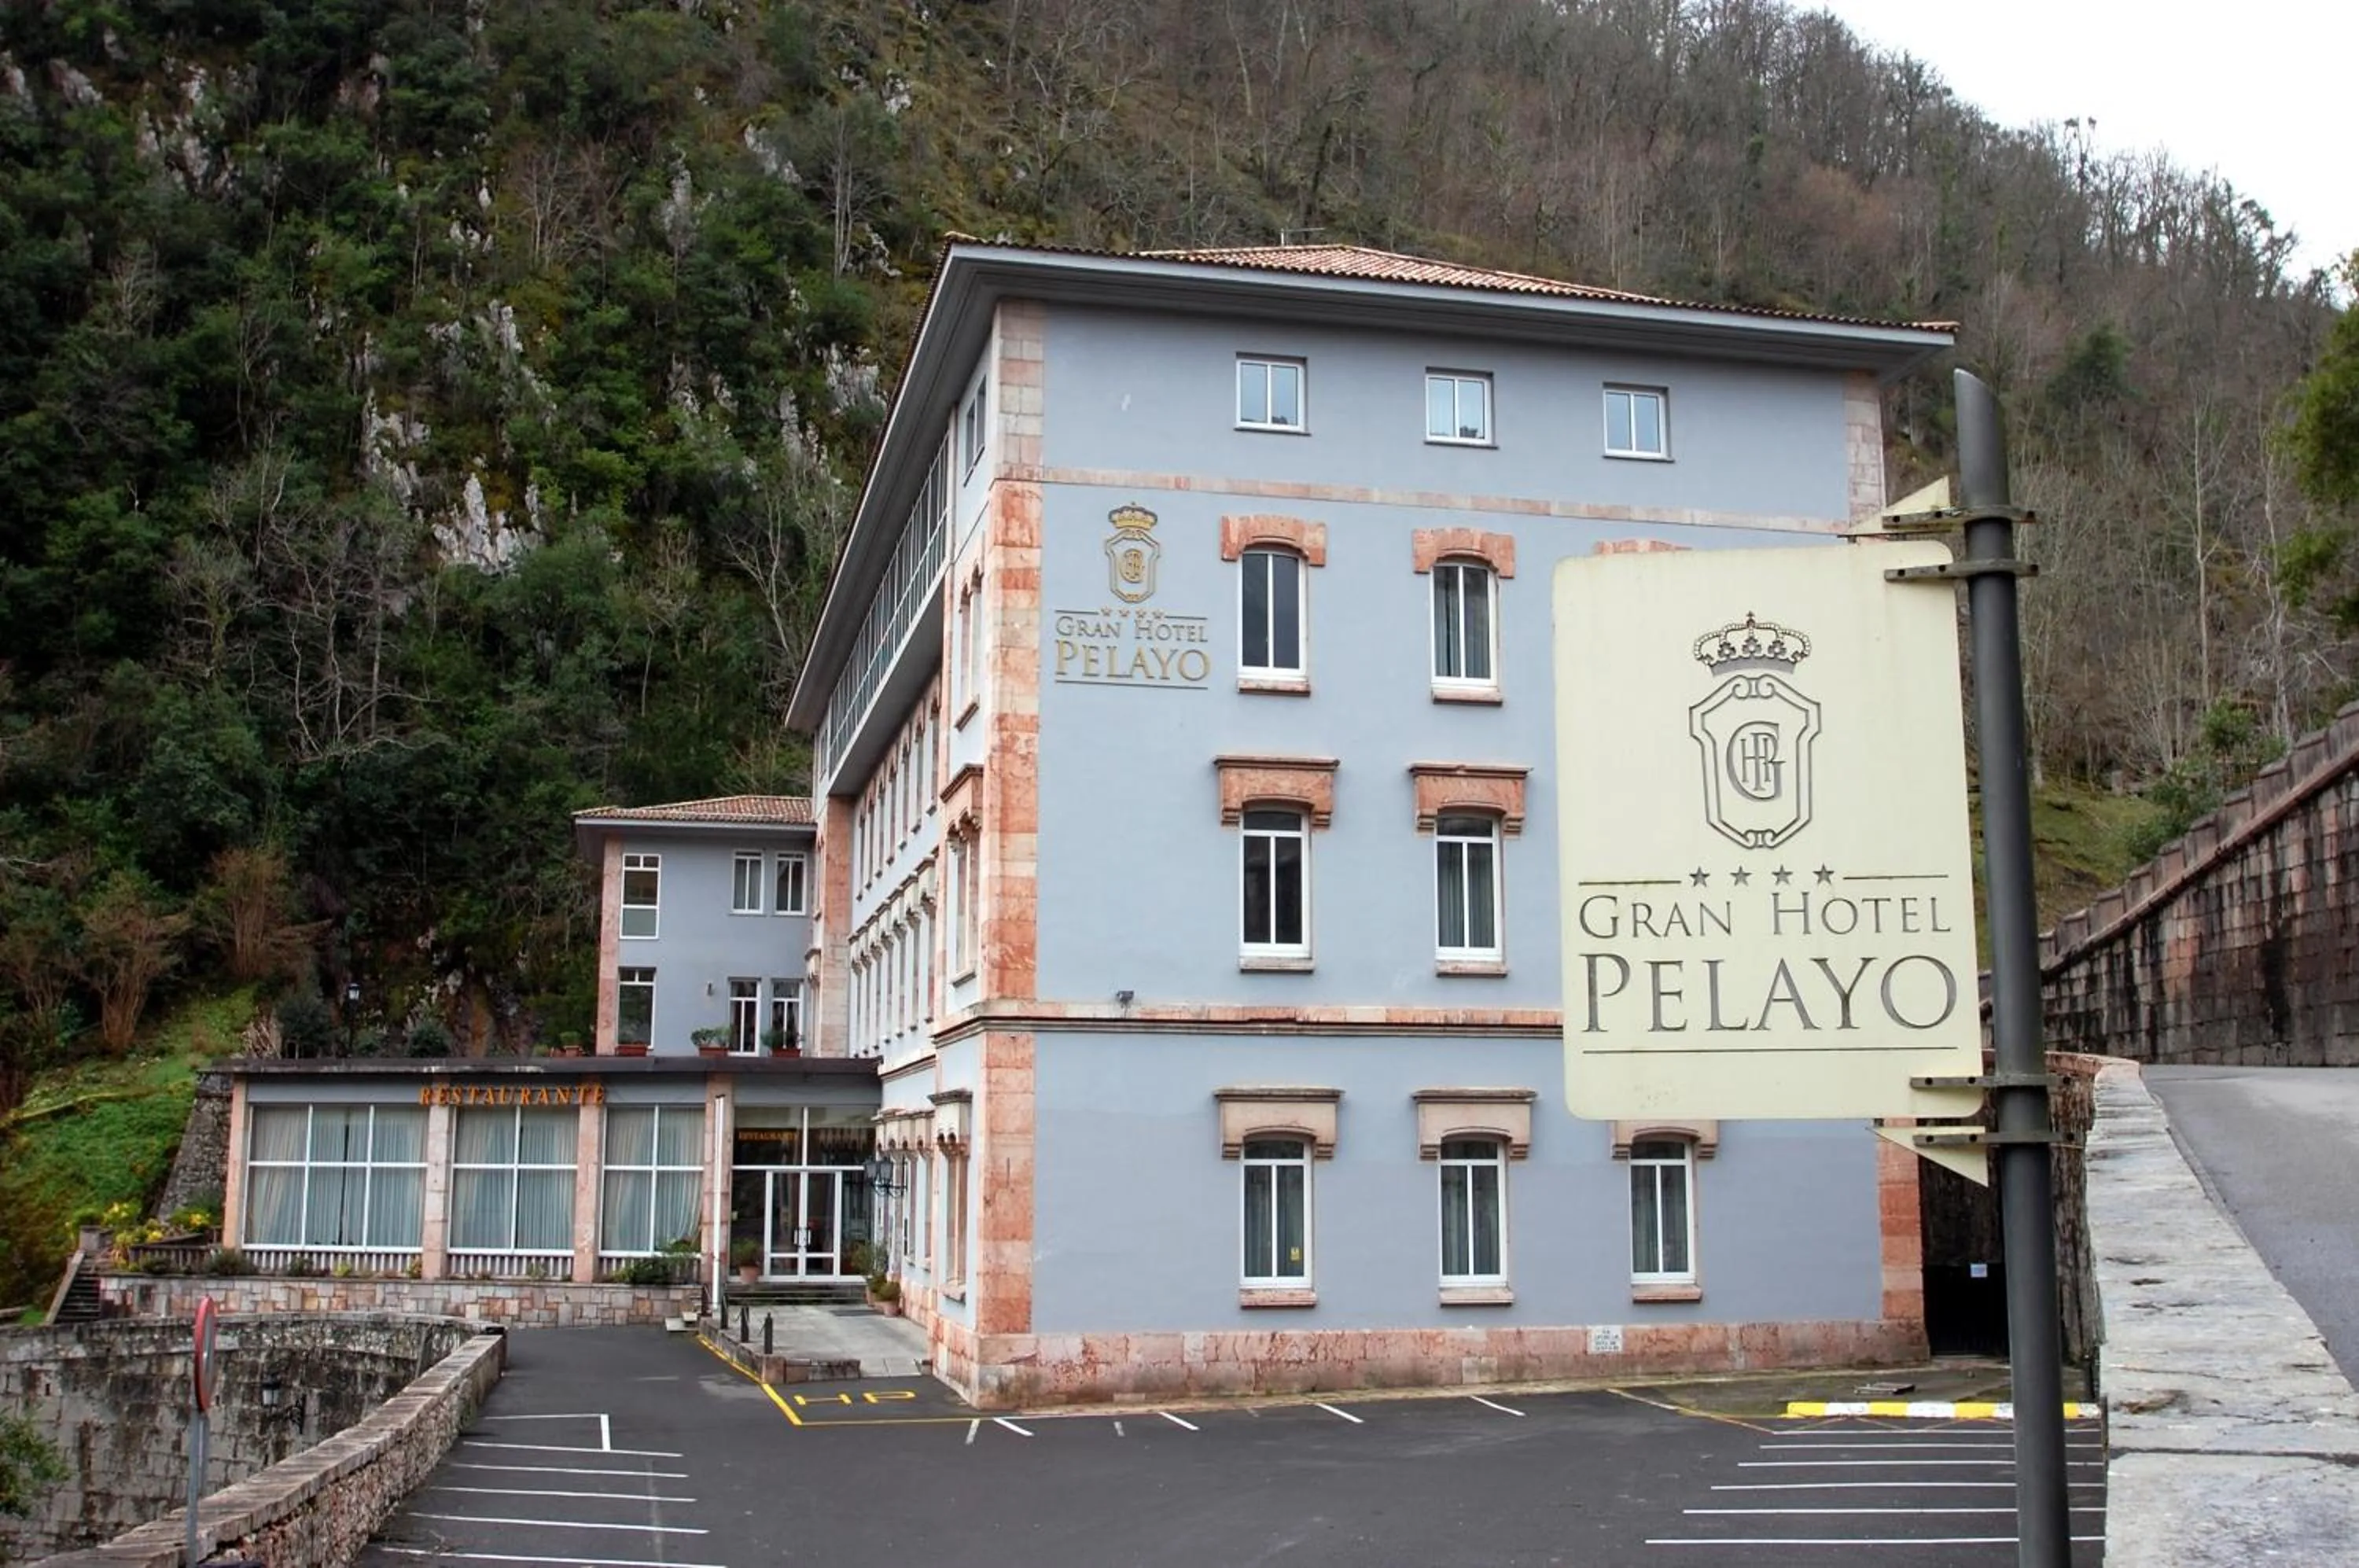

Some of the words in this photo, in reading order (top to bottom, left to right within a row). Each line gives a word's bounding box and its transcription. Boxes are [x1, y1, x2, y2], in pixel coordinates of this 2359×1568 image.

[1054, 616, 1121, 638] GRAN
[1134, 619, 1209, 642] HOTEL
[1054, 639, 1211, 682] PELAYO
[1578, 894, 1733, 939] GRAN
[1772, 892, 1952, 936] HOTEL
[1579, 953, 1958, 1032] PELAYO
[418, 1082, 606, 1107] RESTAURANTE
